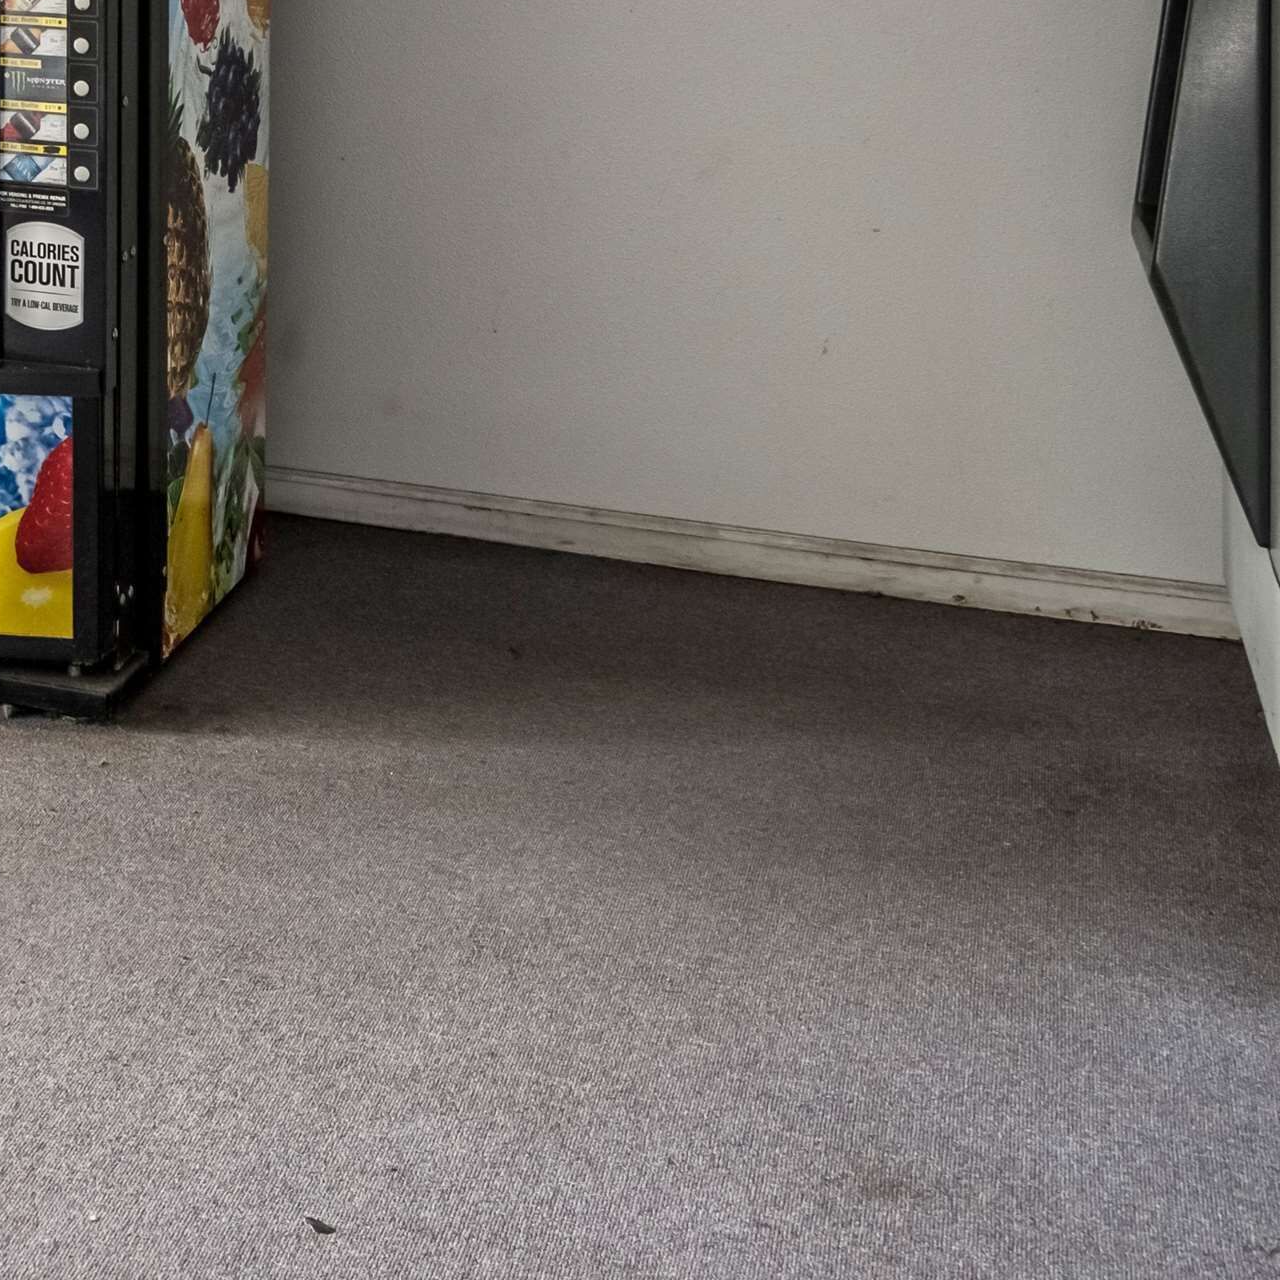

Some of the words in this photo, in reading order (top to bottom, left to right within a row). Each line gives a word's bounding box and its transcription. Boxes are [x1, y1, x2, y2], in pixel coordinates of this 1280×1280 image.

[10, 239, 80, 263] CALORIES
[10, 259, 80, 289] COUNT
[10, 297, 22, 308] TRY
[22, 298, 27, 308] A
[52, 302, 79, 314] BEVERAGE
